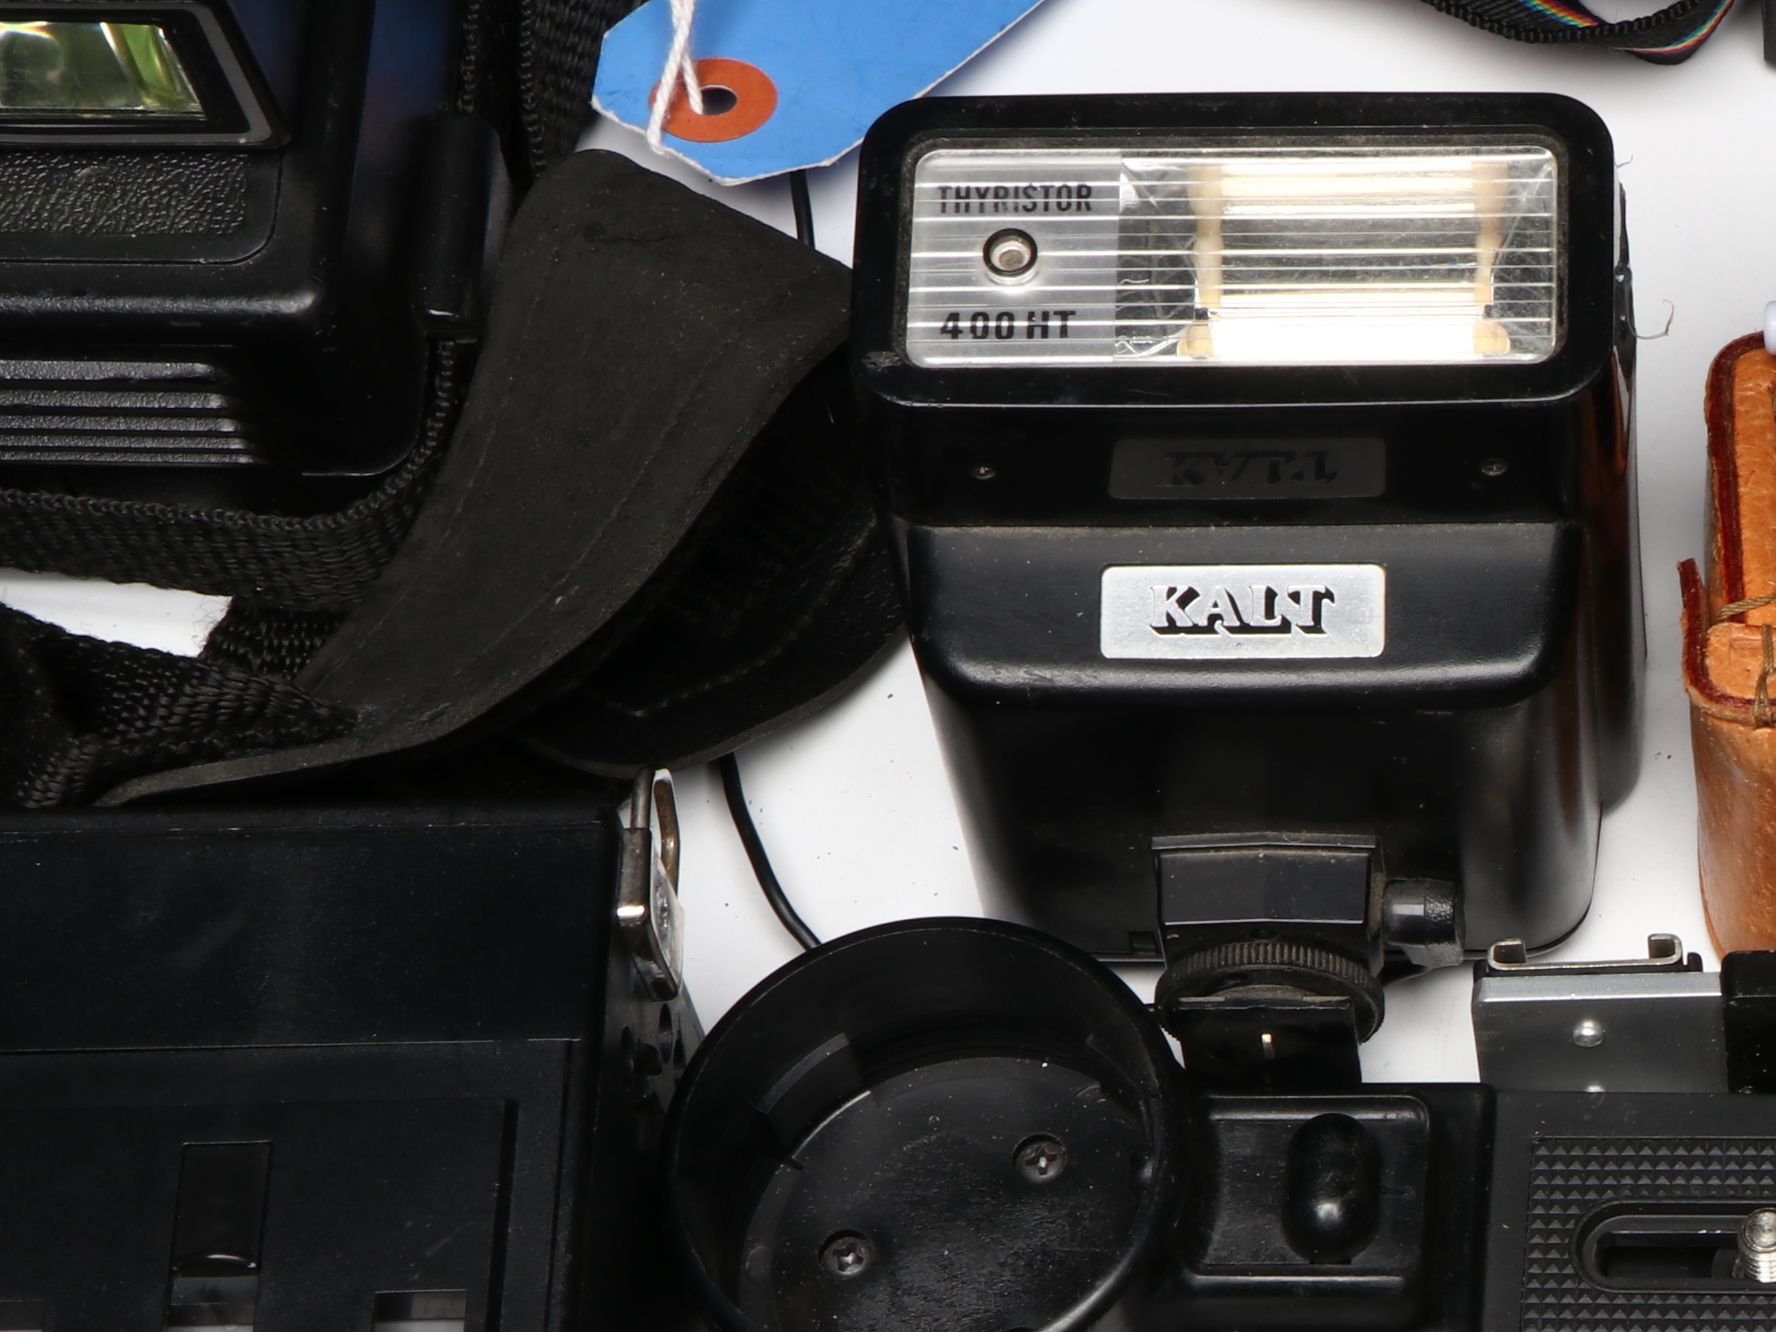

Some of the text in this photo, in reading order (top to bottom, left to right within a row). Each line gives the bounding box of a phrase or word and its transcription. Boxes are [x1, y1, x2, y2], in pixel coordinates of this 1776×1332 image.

[937, 184, 1092, 214] THYRISTOR
[940, 310, 1077, 340] 400 HT
[1150, 584, 1336, 637] KALT
